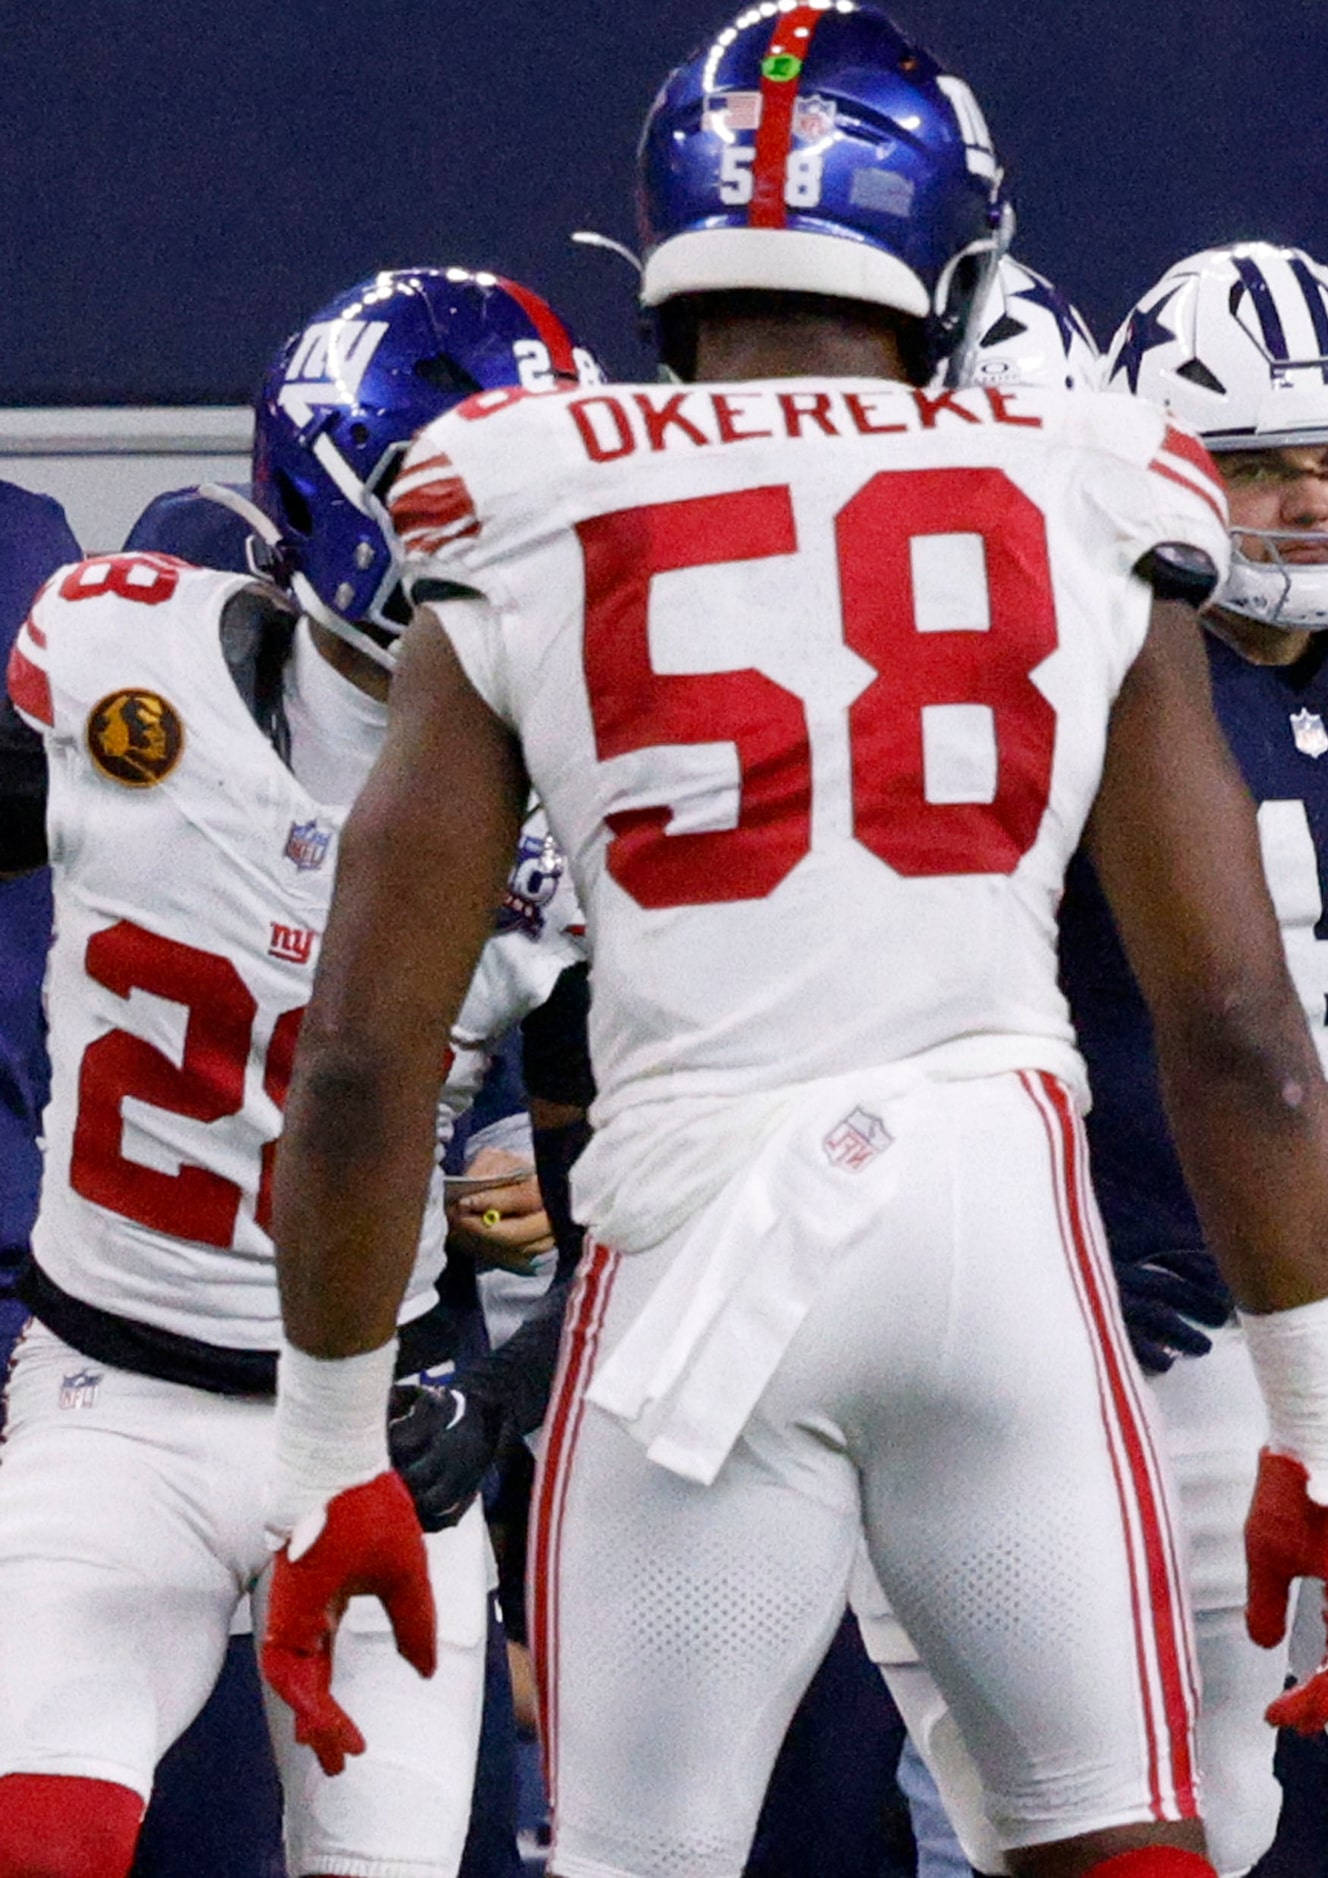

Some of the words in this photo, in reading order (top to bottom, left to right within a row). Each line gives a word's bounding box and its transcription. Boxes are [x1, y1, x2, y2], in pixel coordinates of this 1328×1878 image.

[720, 146, 824, 208] 58
[568, 385, 1043, 463] OKEREKE
[574, 467, 1060, 910] 58
